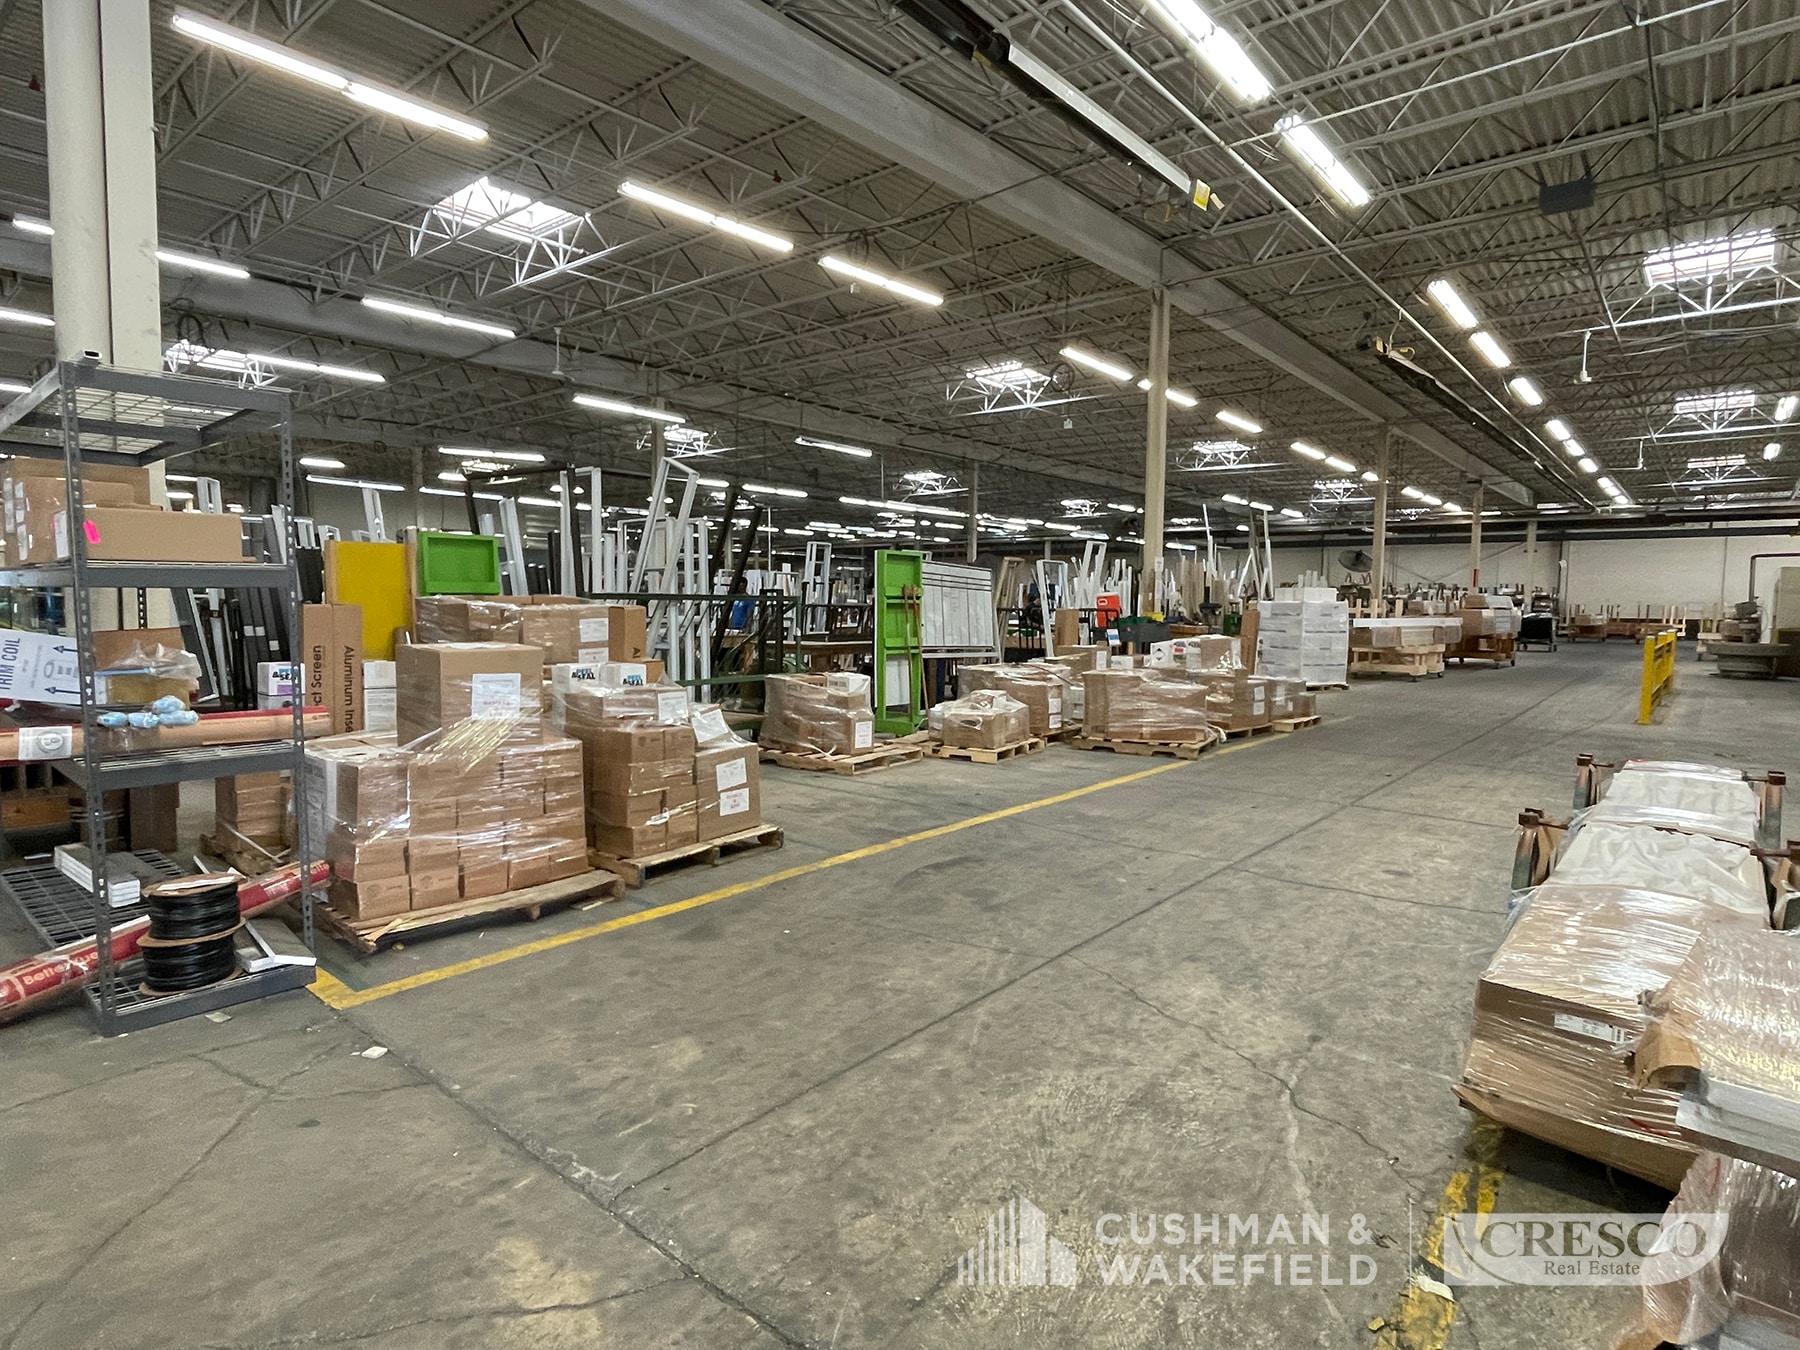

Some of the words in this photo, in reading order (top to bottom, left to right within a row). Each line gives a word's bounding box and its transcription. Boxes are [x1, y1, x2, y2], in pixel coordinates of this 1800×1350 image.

[2, 638, 21, 662] COIL
[311, 645, 323, 689] Screen
[343, 645, 355, 706] Aluminum
[344, 709, 355, 733] Inse
